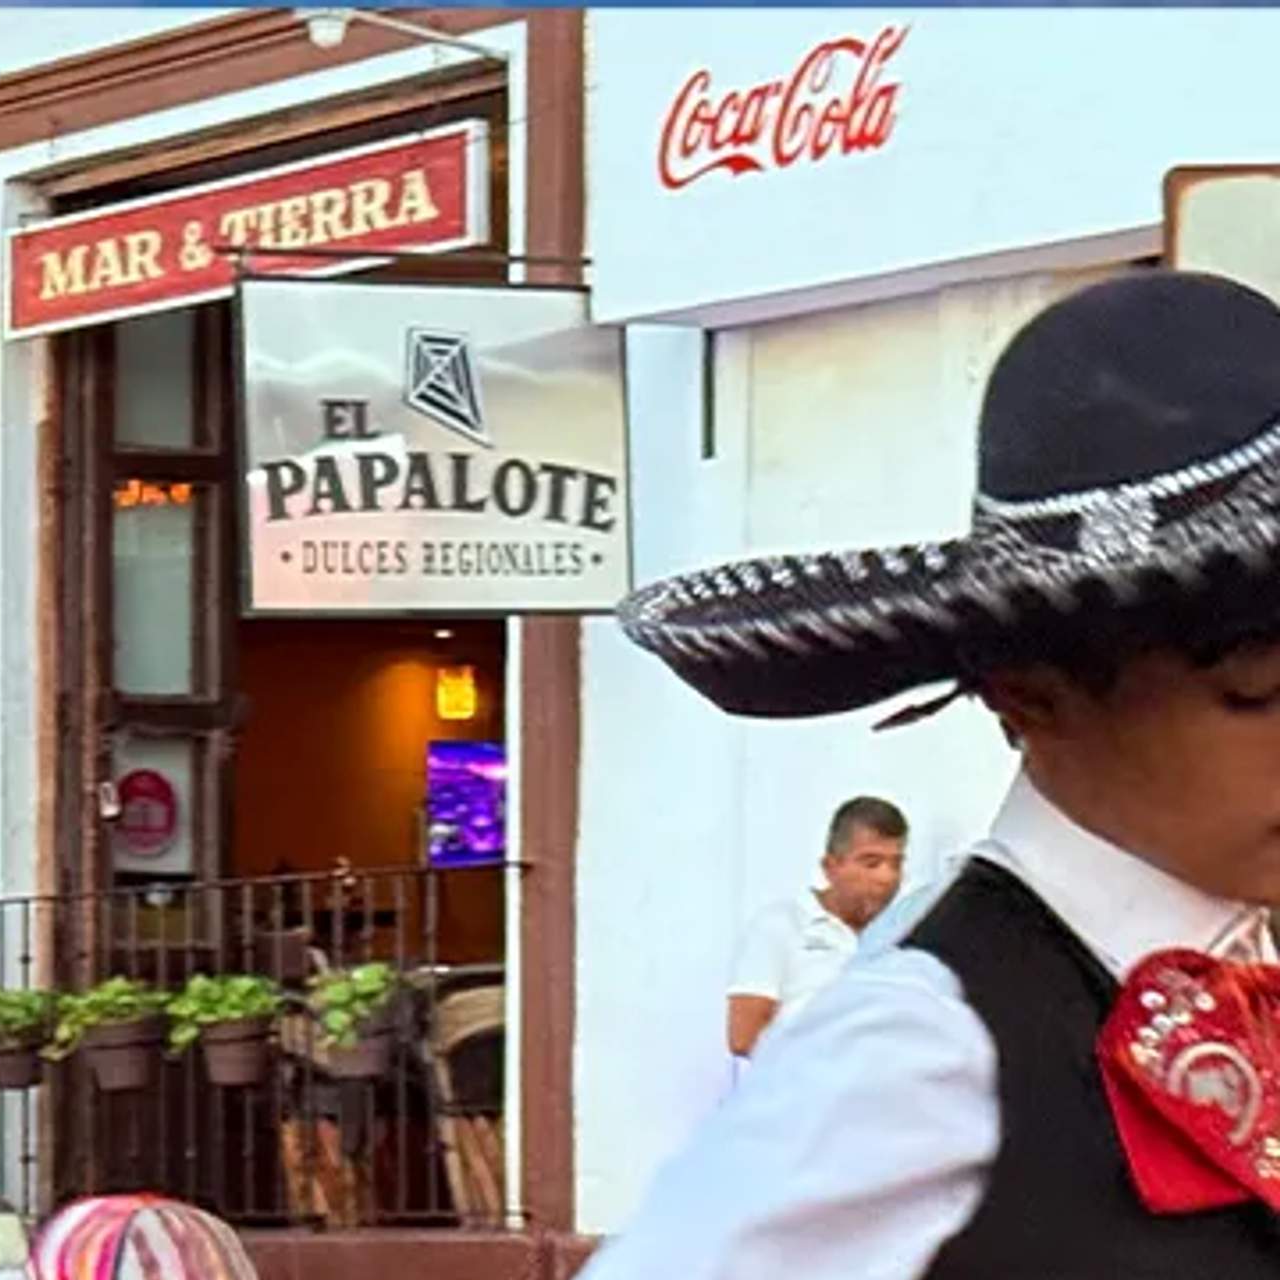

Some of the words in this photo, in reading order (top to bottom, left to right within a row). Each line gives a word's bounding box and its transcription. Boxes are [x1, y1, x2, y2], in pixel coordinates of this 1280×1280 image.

[658, 25, 910, 188] Coca-Cola
[40, 230, 164, 299] MAR
[179, 221, 215, 271] &
[219, 169, 438, 263] TIERRA
[320, 399, 380, 440] EL
[258, 451, 617, 533] PAPALOTE
[301, 540, 407, 574] DULCES
[421, 541, 585, 576] REGIONALES
